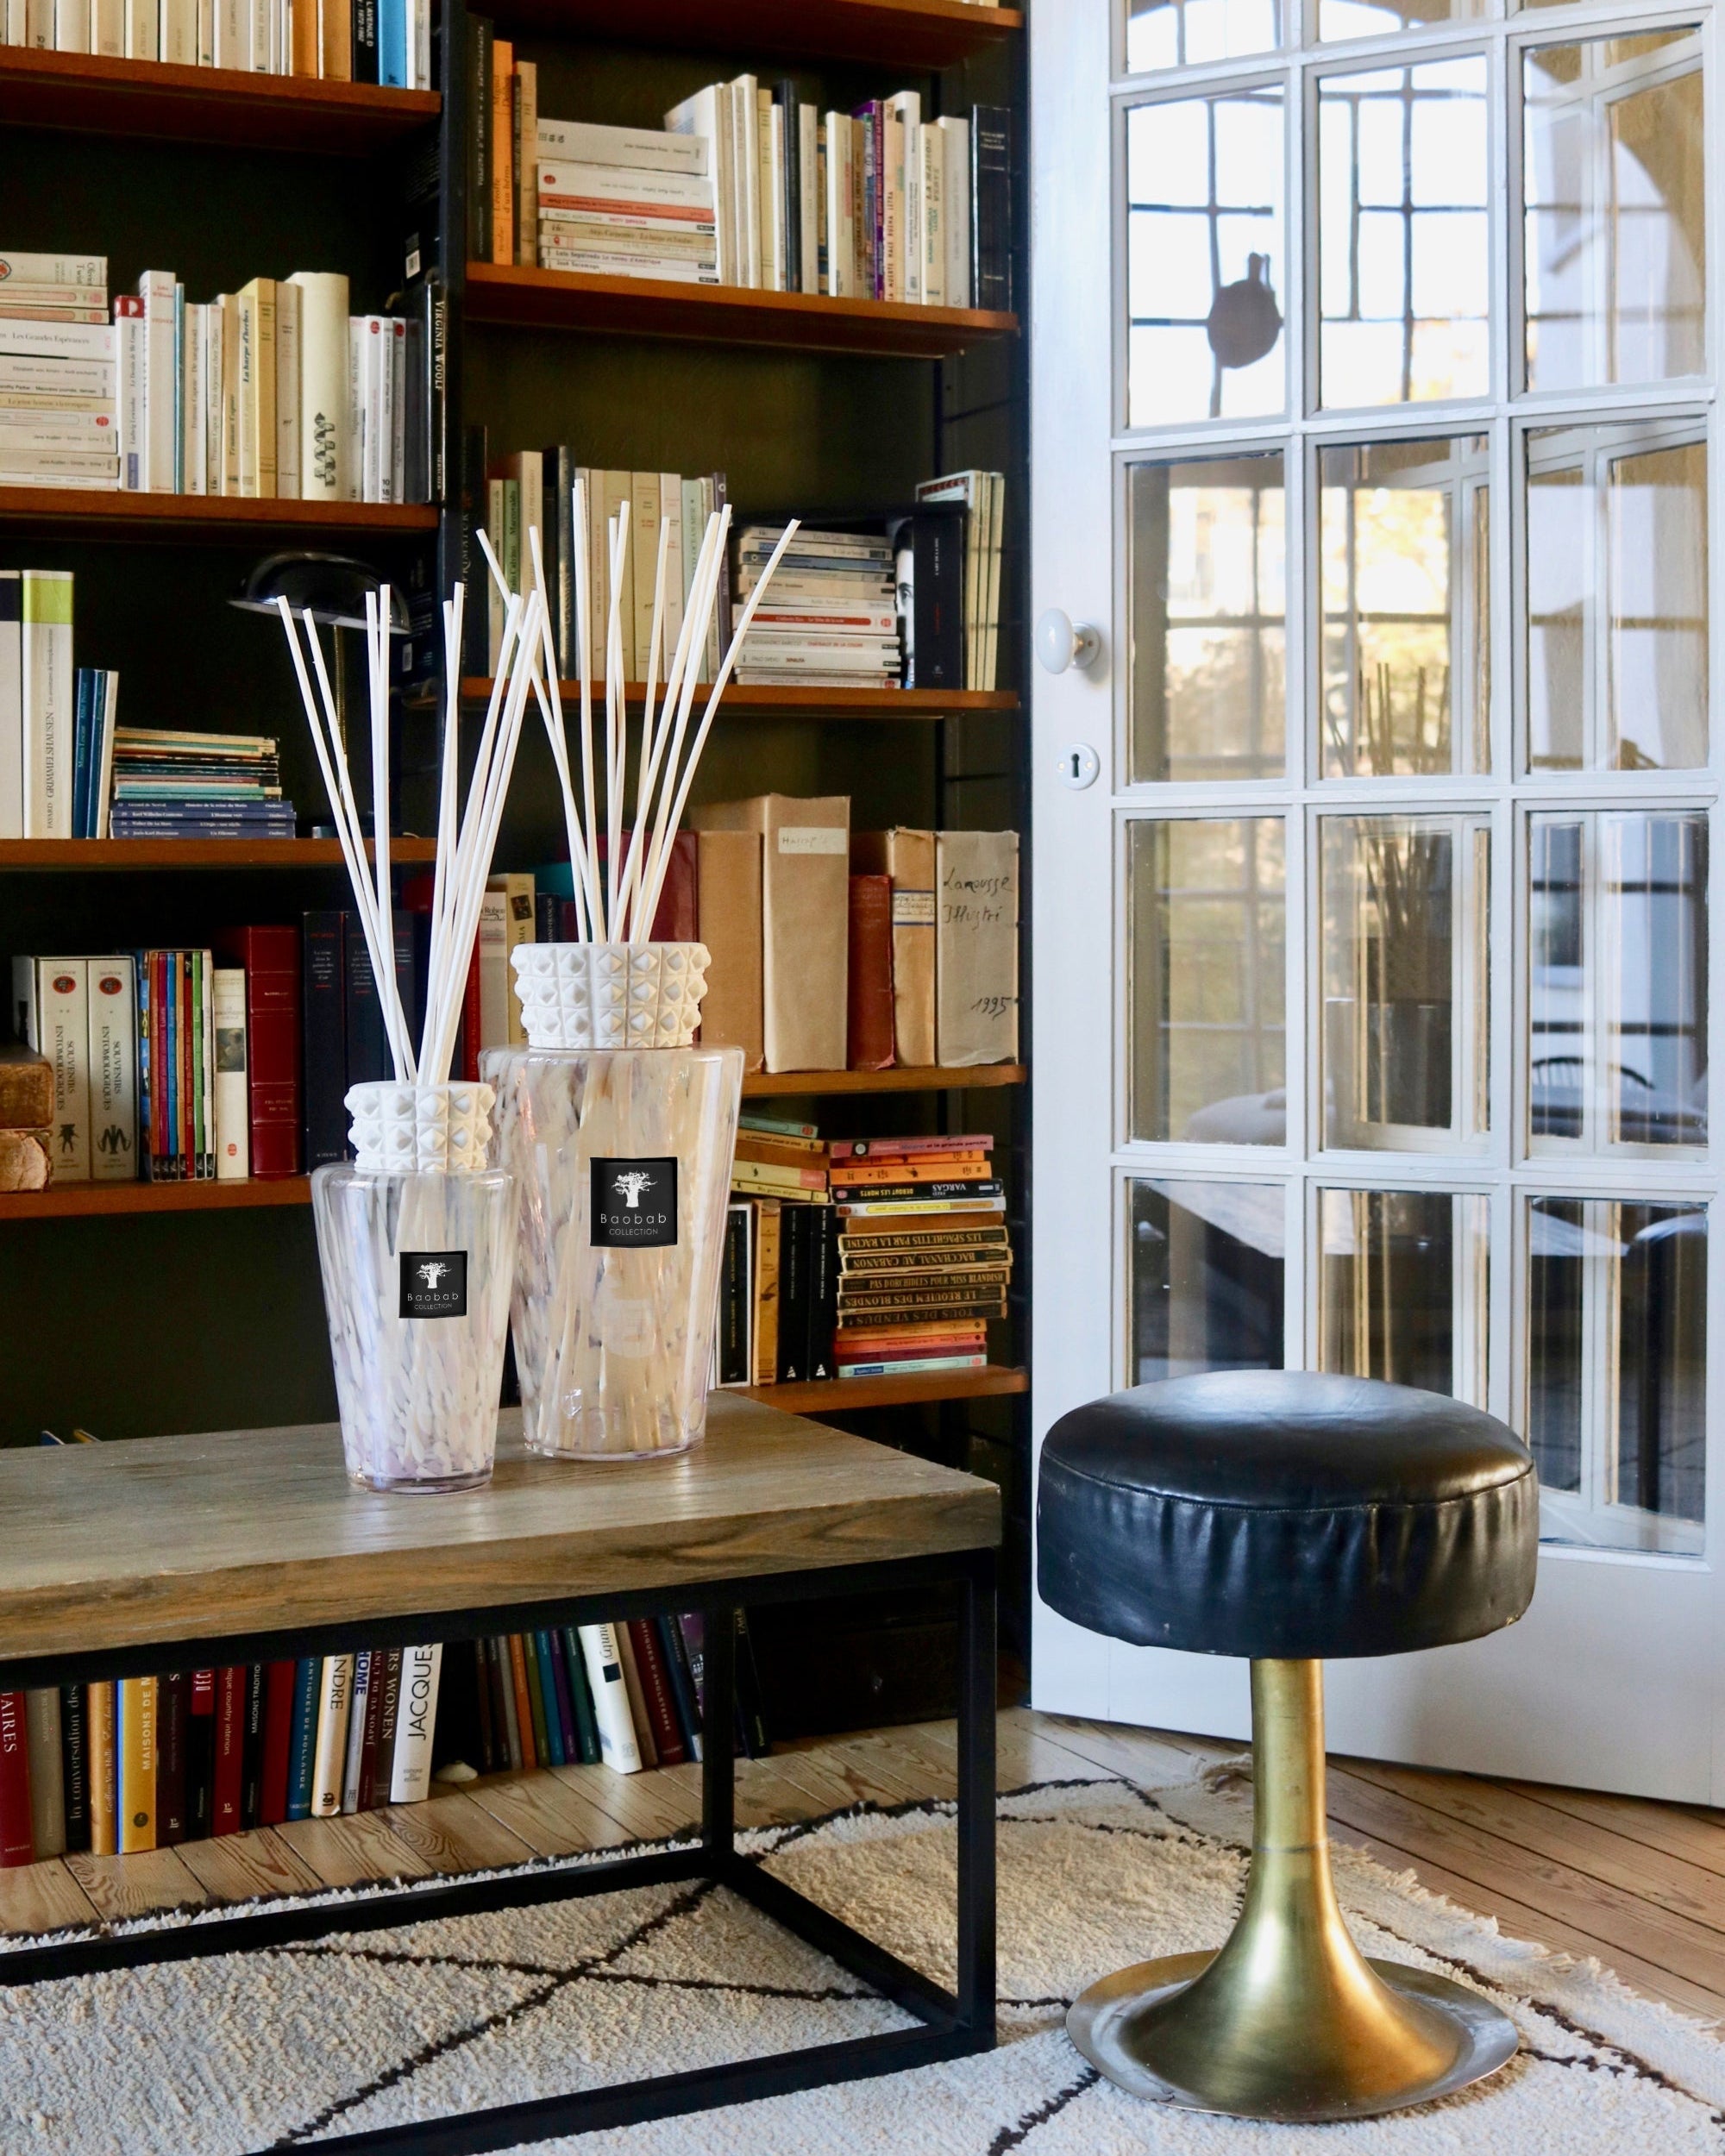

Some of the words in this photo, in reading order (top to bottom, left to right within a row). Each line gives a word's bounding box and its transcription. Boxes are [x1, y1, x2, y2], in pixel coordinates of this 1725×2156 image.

[435, 300, 446, 349] VIRGINIA
[435, 354, 446, 392] WOOLF
[46, 711, 55, 799] GRIMMELSHAUSEN
[971, 997, 1012, 1020] 1995
[55, 1025, 65, 1111] ENTOMOLOGIQUES
[66, 1040, 76, 1094] SOUVENIRS
[102, 1025, 112, 1111] ENTOMOLOGIQUES
[113, 1040, 122, 1094] SOUVENIRS
[932, 1182, 967, 1192] VARGAS
[600, 1213, 668, 1225] Baobab
[609, 1228, 659, 1237] COLLECTION
[965, 1232, 982, 1243] LES
[846, 1238, 878, 1249] RACINE
[879, 1238, 891, 1247] LA
[894, 1236, 911, 1247] PAR
[912, 1234, 965, 1246] SPAGHETTIS
[852, 1257, 900, 1269] CABANON
[902, 1256, 916, 1266] AU
[919, 1252, 975, 1265] BACCHANAL
[406, 1293, 459, 1302] Baobab
[894, 1294, 913, 1304] DES
[915, 1291, 962, 1303] REQUIEM
[963, 1289, 977, 1300] LE
[844, 1296, 892, 1307] BLONDES
[855, 1313, 910, 1325] VENDUS
[913, 1311, 938, 1321] DES
[941, 1307, 974, 1319] TOUS
[225, 1667, 234, 1690] nique
[329, 1655, 348, 1710] NDRE
[141, 1690, 151, 1707] DE
[223, 1690, 233, 1722] country
[381, 1677, 398, 1739] WONEN
[1, 1691, 17, 1753] AIRES
[250, 1700, 260, 1734] MAISONS
[304, 1717, 310, 1730] DE
[141, 1711, 152, 1770] MAISONS
[69, 1714, 83, 1801] conversation
[298, 1734, 309, 1789] HOLLANDE
